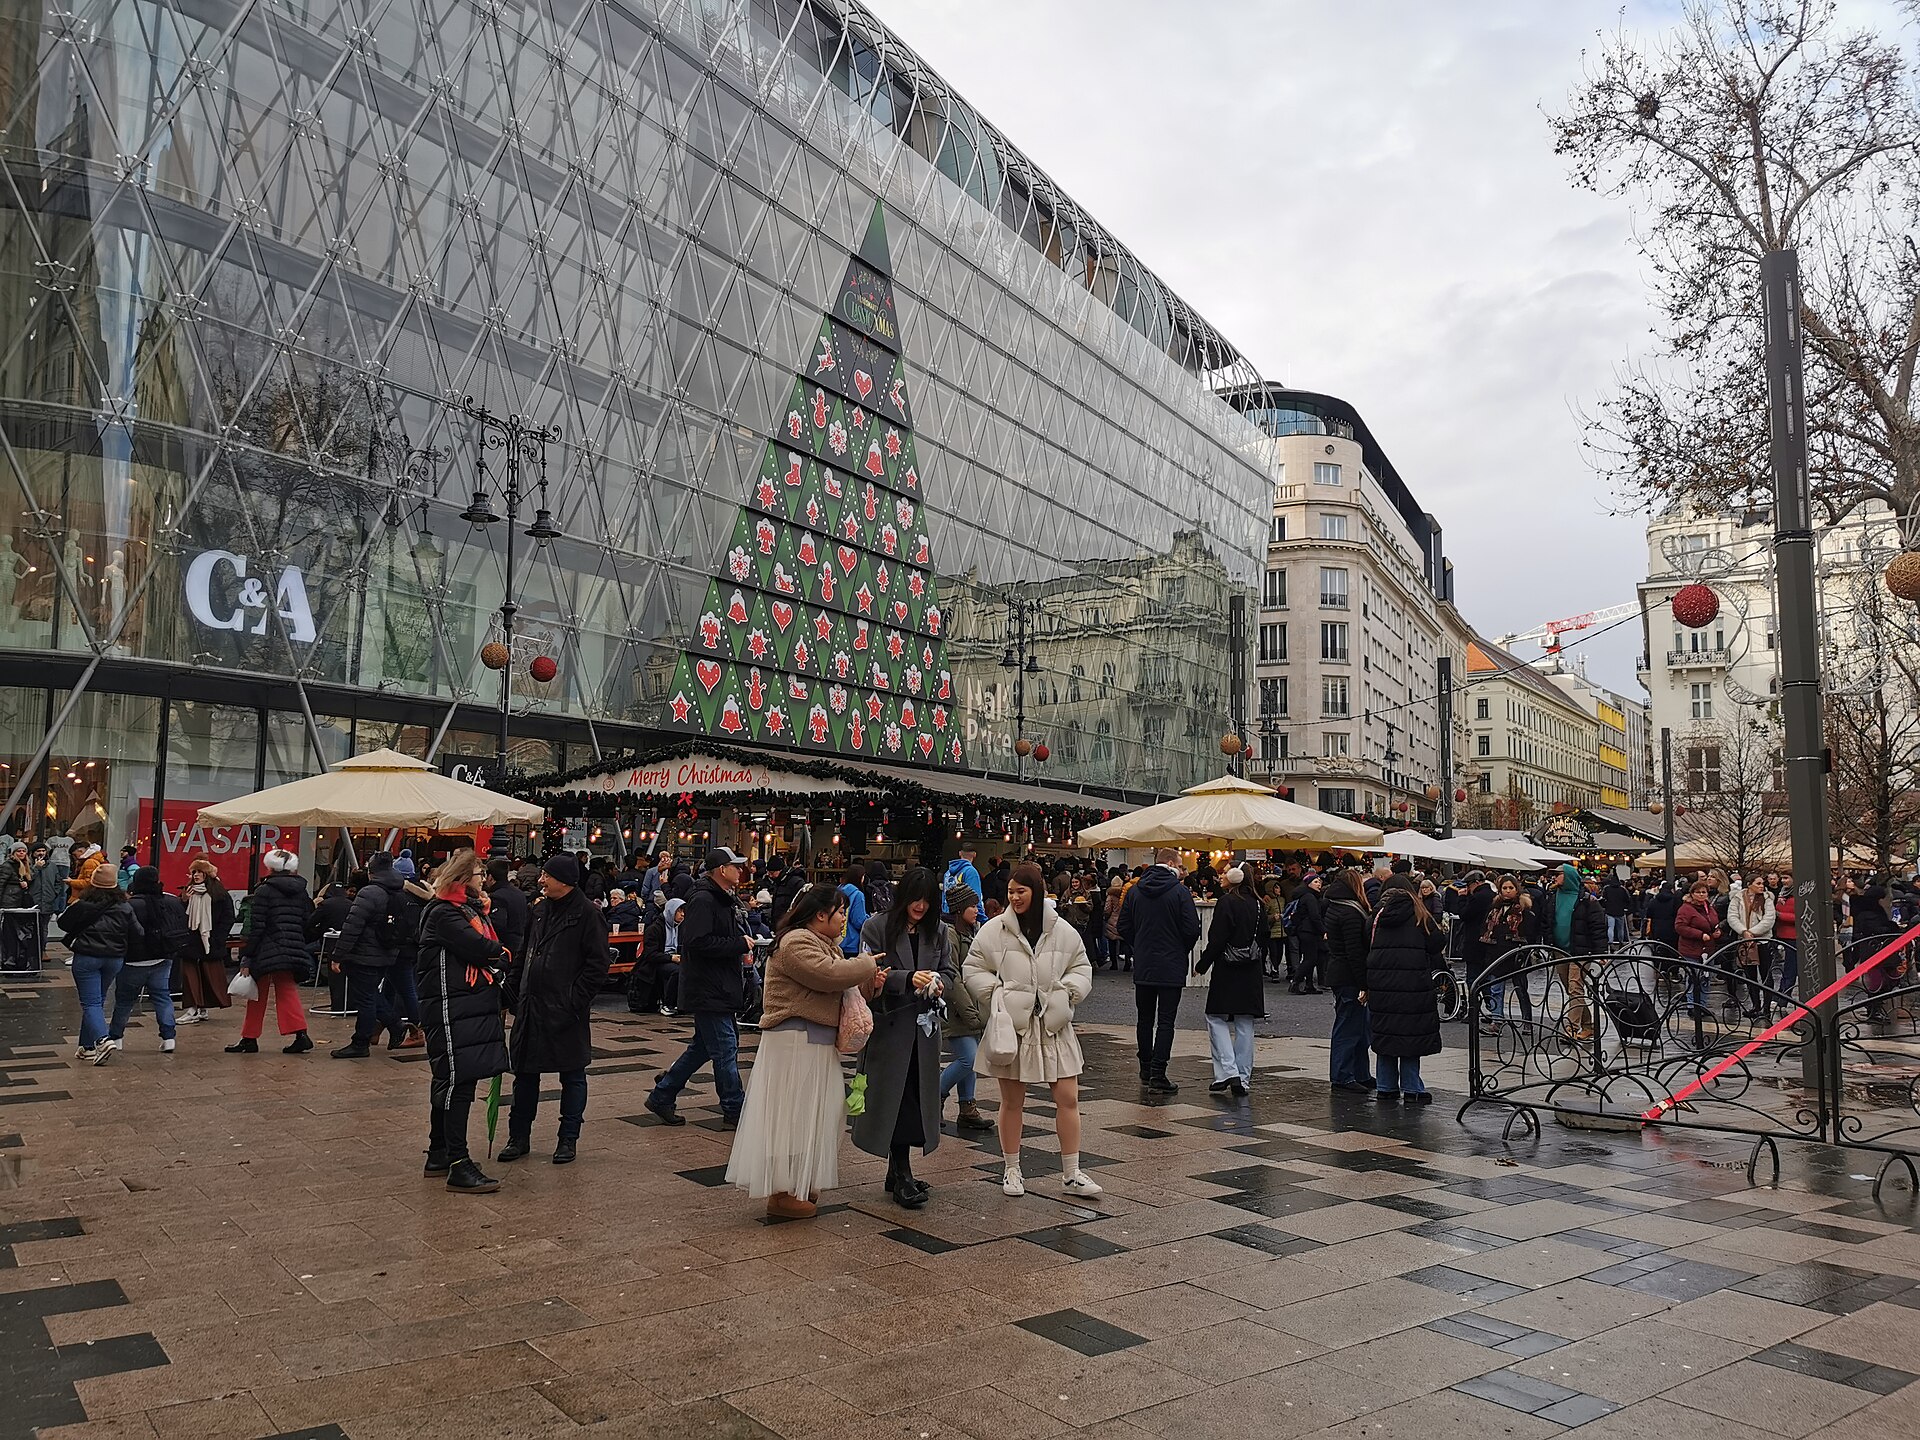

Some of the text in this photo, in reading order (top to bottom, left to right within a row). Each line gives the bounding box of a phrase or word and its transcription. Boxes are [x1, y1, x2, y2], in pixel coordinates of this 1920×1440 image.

[186, 550, 323, 644] C&A
[967, 719, 1012, 757] Price
[451, 764, 486, 787] C&A
[628, 763, 752, 788] Merry Christmas
